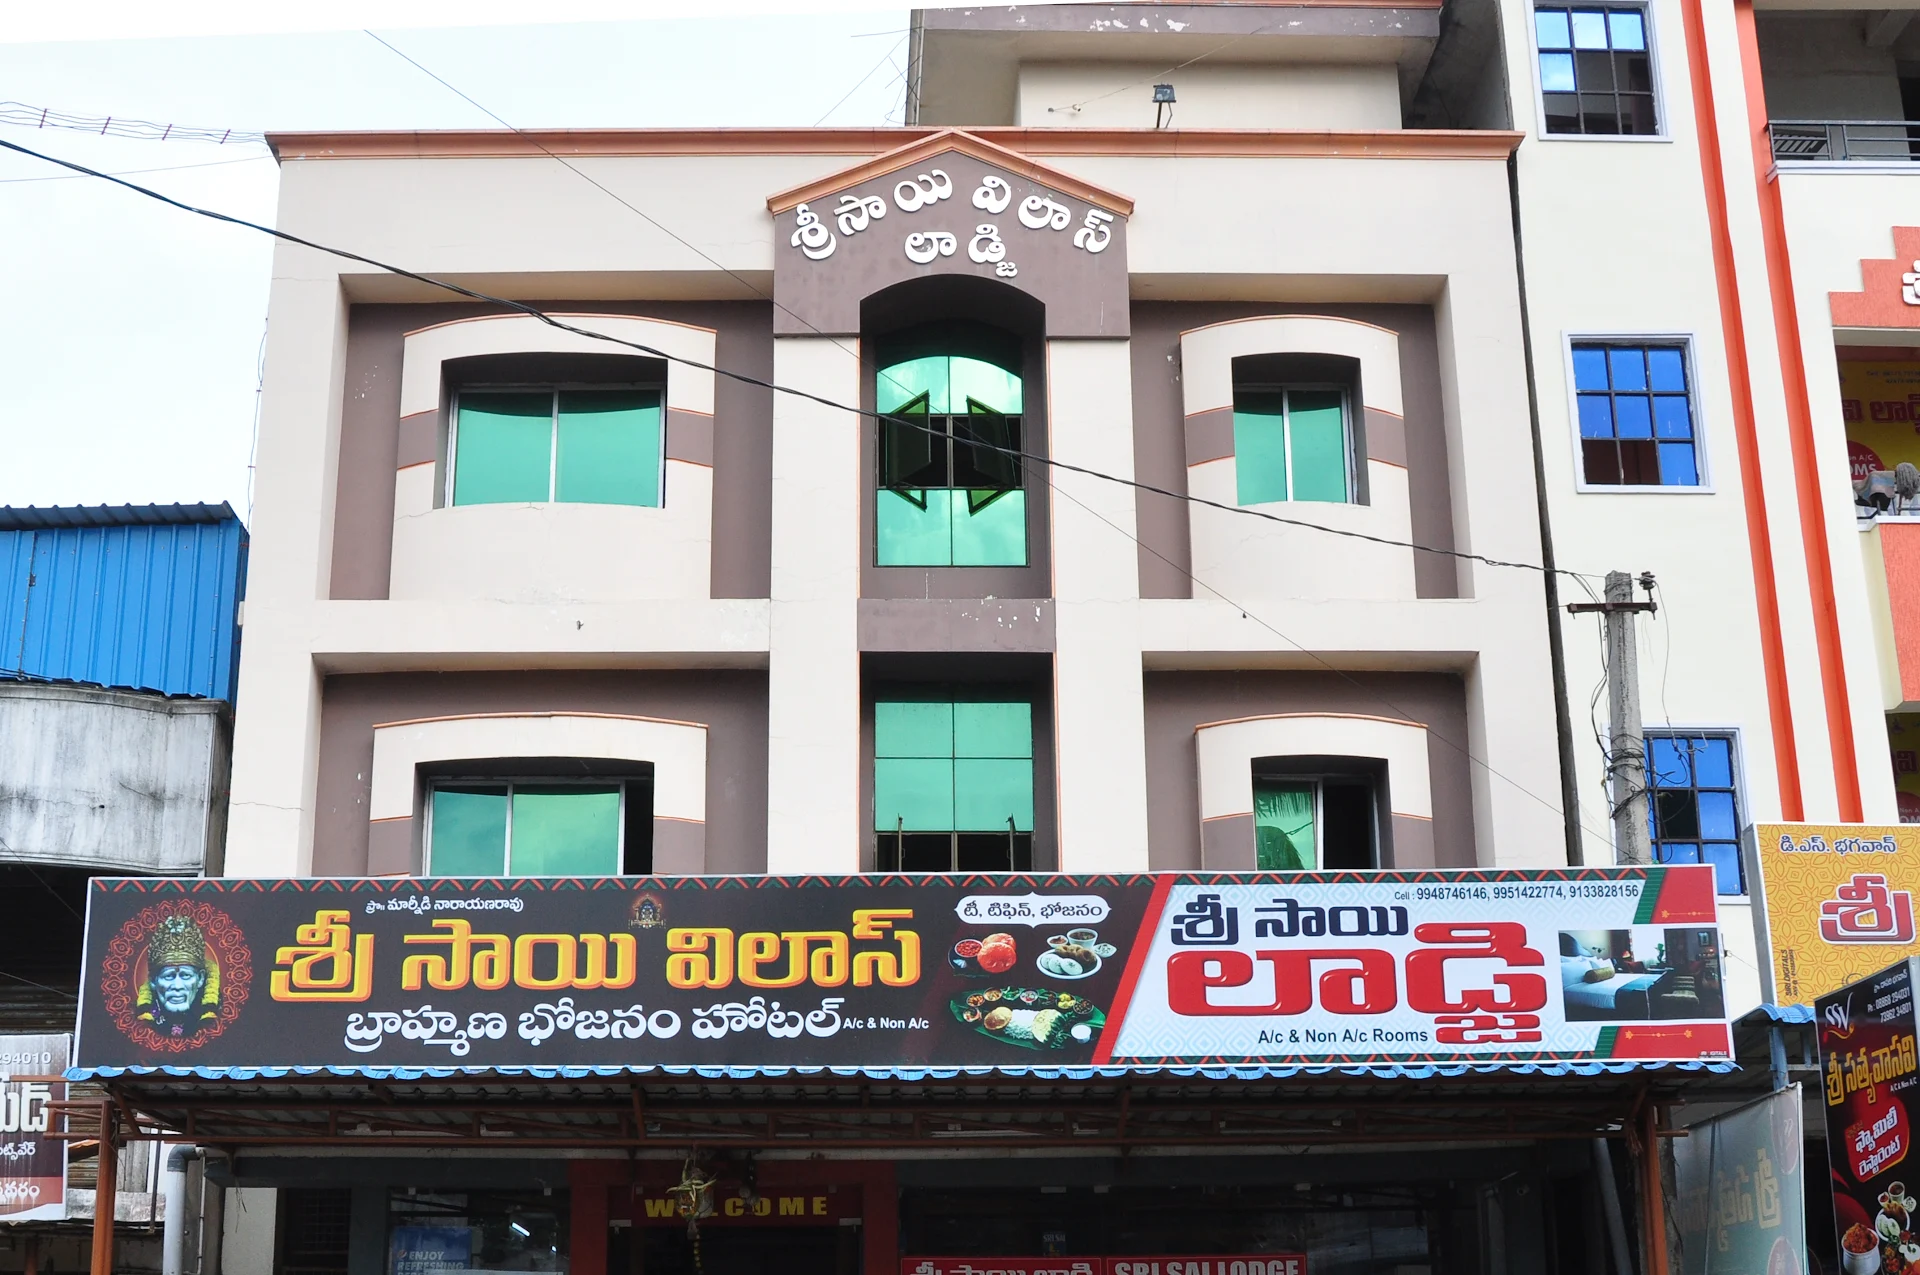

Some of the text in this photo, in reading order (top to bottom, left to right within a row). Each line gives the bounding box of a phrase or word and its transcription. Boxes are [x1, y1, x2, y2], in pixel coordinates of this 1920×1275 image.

[791, 169, 1114, 260] శ్రీ సాయి విలాస్
[1834, 836, 1897, 854] భగవాన్
[1394, 891, 1410, 901] Cell
[1416, 887, 1491, 901] 9948746146,
[1493, 886, 1567, 900] 9951422774,
[1569, 884, 1640, 898] 9133828156
[434, 897, 524, 912] నారాయణరావు
[1040, 902, 1103, 919] భోజనం
[1820, 875, 1914, 943] శ్రీ
[1170, 894, 1409, 946] శ్రీ సాయి
[269, 908, 922, 1002] శ్రీ సాయి విలాస్
[1781, 949, 1791, 982] DIGITALS
[343, 996, 845, 1057] బ్రాహ్మణ భోజనం హోటల్
[843, 1017, 929, 1029] A/c & Non A/c
[1258, 1028, 1428, 1044] A/c & Non A/c Rooms
[1827, 1051, 1845, 1106] శ్రీ
[644, 1196, 829, 1218] WCOME
[397, 1261, 465, 1271] REFRESHING
[409, 1251, 445, 1261] ENJOY
